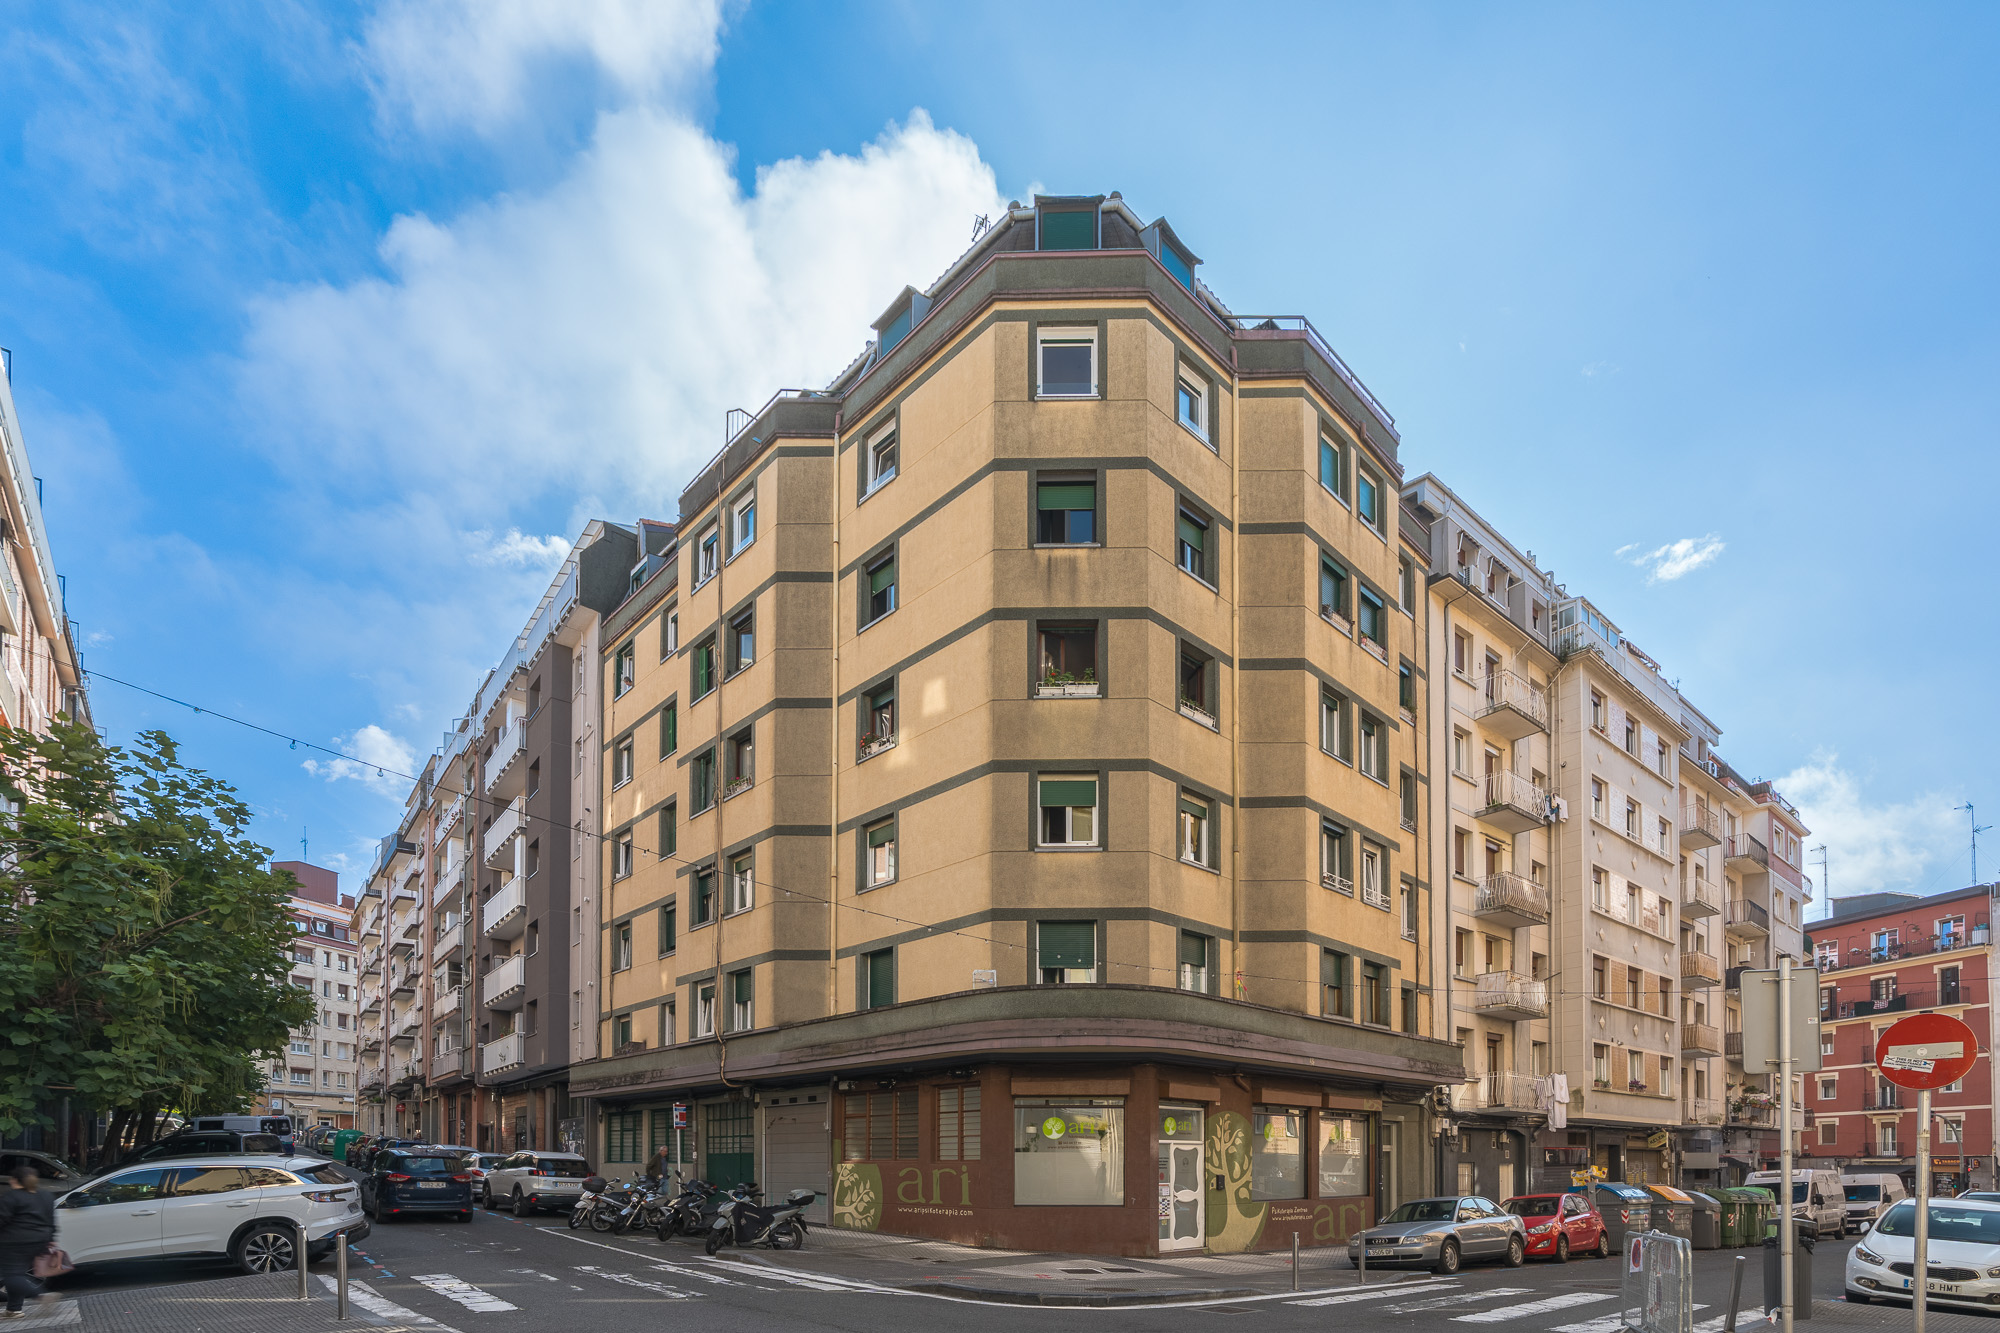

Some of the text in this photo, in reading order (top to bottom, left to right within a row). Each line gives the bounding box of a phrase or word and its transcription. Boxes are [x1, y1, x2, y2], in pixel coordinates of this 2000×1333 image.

[1068, 1117, 1096, 1134] ari
[1178, 1117, 1192, 1131] ari
[897, 1165, 973, 1205] ari
[898, 1207, 974, 1217] www.aripsikoterapia.com
[1313, 1200, 1366, 1240] ari
[1911, 1281, 1960, 1293] 58 HMT
